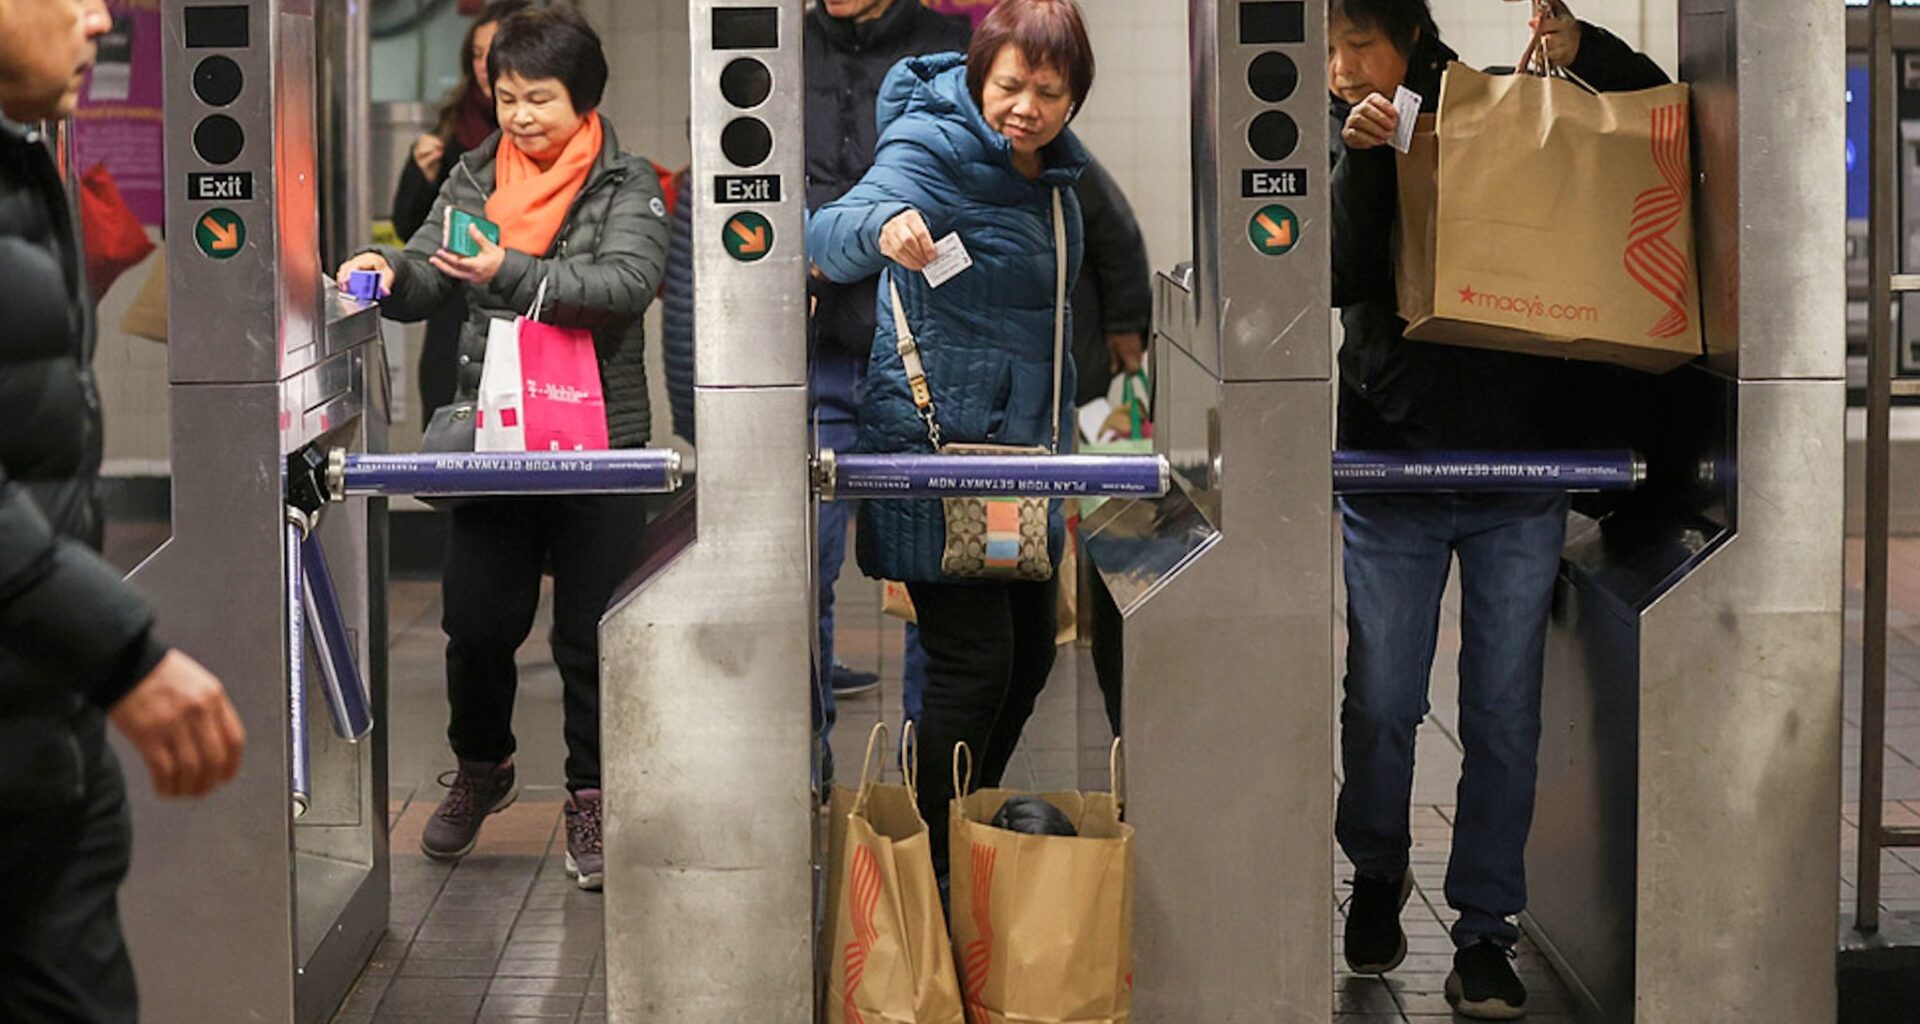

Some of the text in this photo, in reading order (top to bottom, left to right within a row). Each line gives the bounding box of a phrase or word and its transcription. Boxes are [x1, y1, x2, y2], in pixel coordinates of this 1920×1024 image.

[199, 176, 242, 197] Exit
[1252, 172, 1297, 194] Exit
[726, 179, 770, 200] Exit
[1479, 292, 1599, 322] macy's.com
[436, 458, 465, 470] NOW
[467, 459, 522, 472] GETAWAY
[525, 460, 558, 471] YOUR
[561, 460, 593, 471] PLAN
[1403, 464, 1432, 475] NOW
[1435, 464, 1490, 476] GETAWAY
[1491, 464, 1525, 476] YOUR
[1528, 465, 1560, 477] PLAN
[927, 477, 957, 488] NOW
[959, 478, 1016, 490] GETAWAY
[1017, 479, 1050, 491] YOUR
[1054, 480, 1087, 491] PLAN
